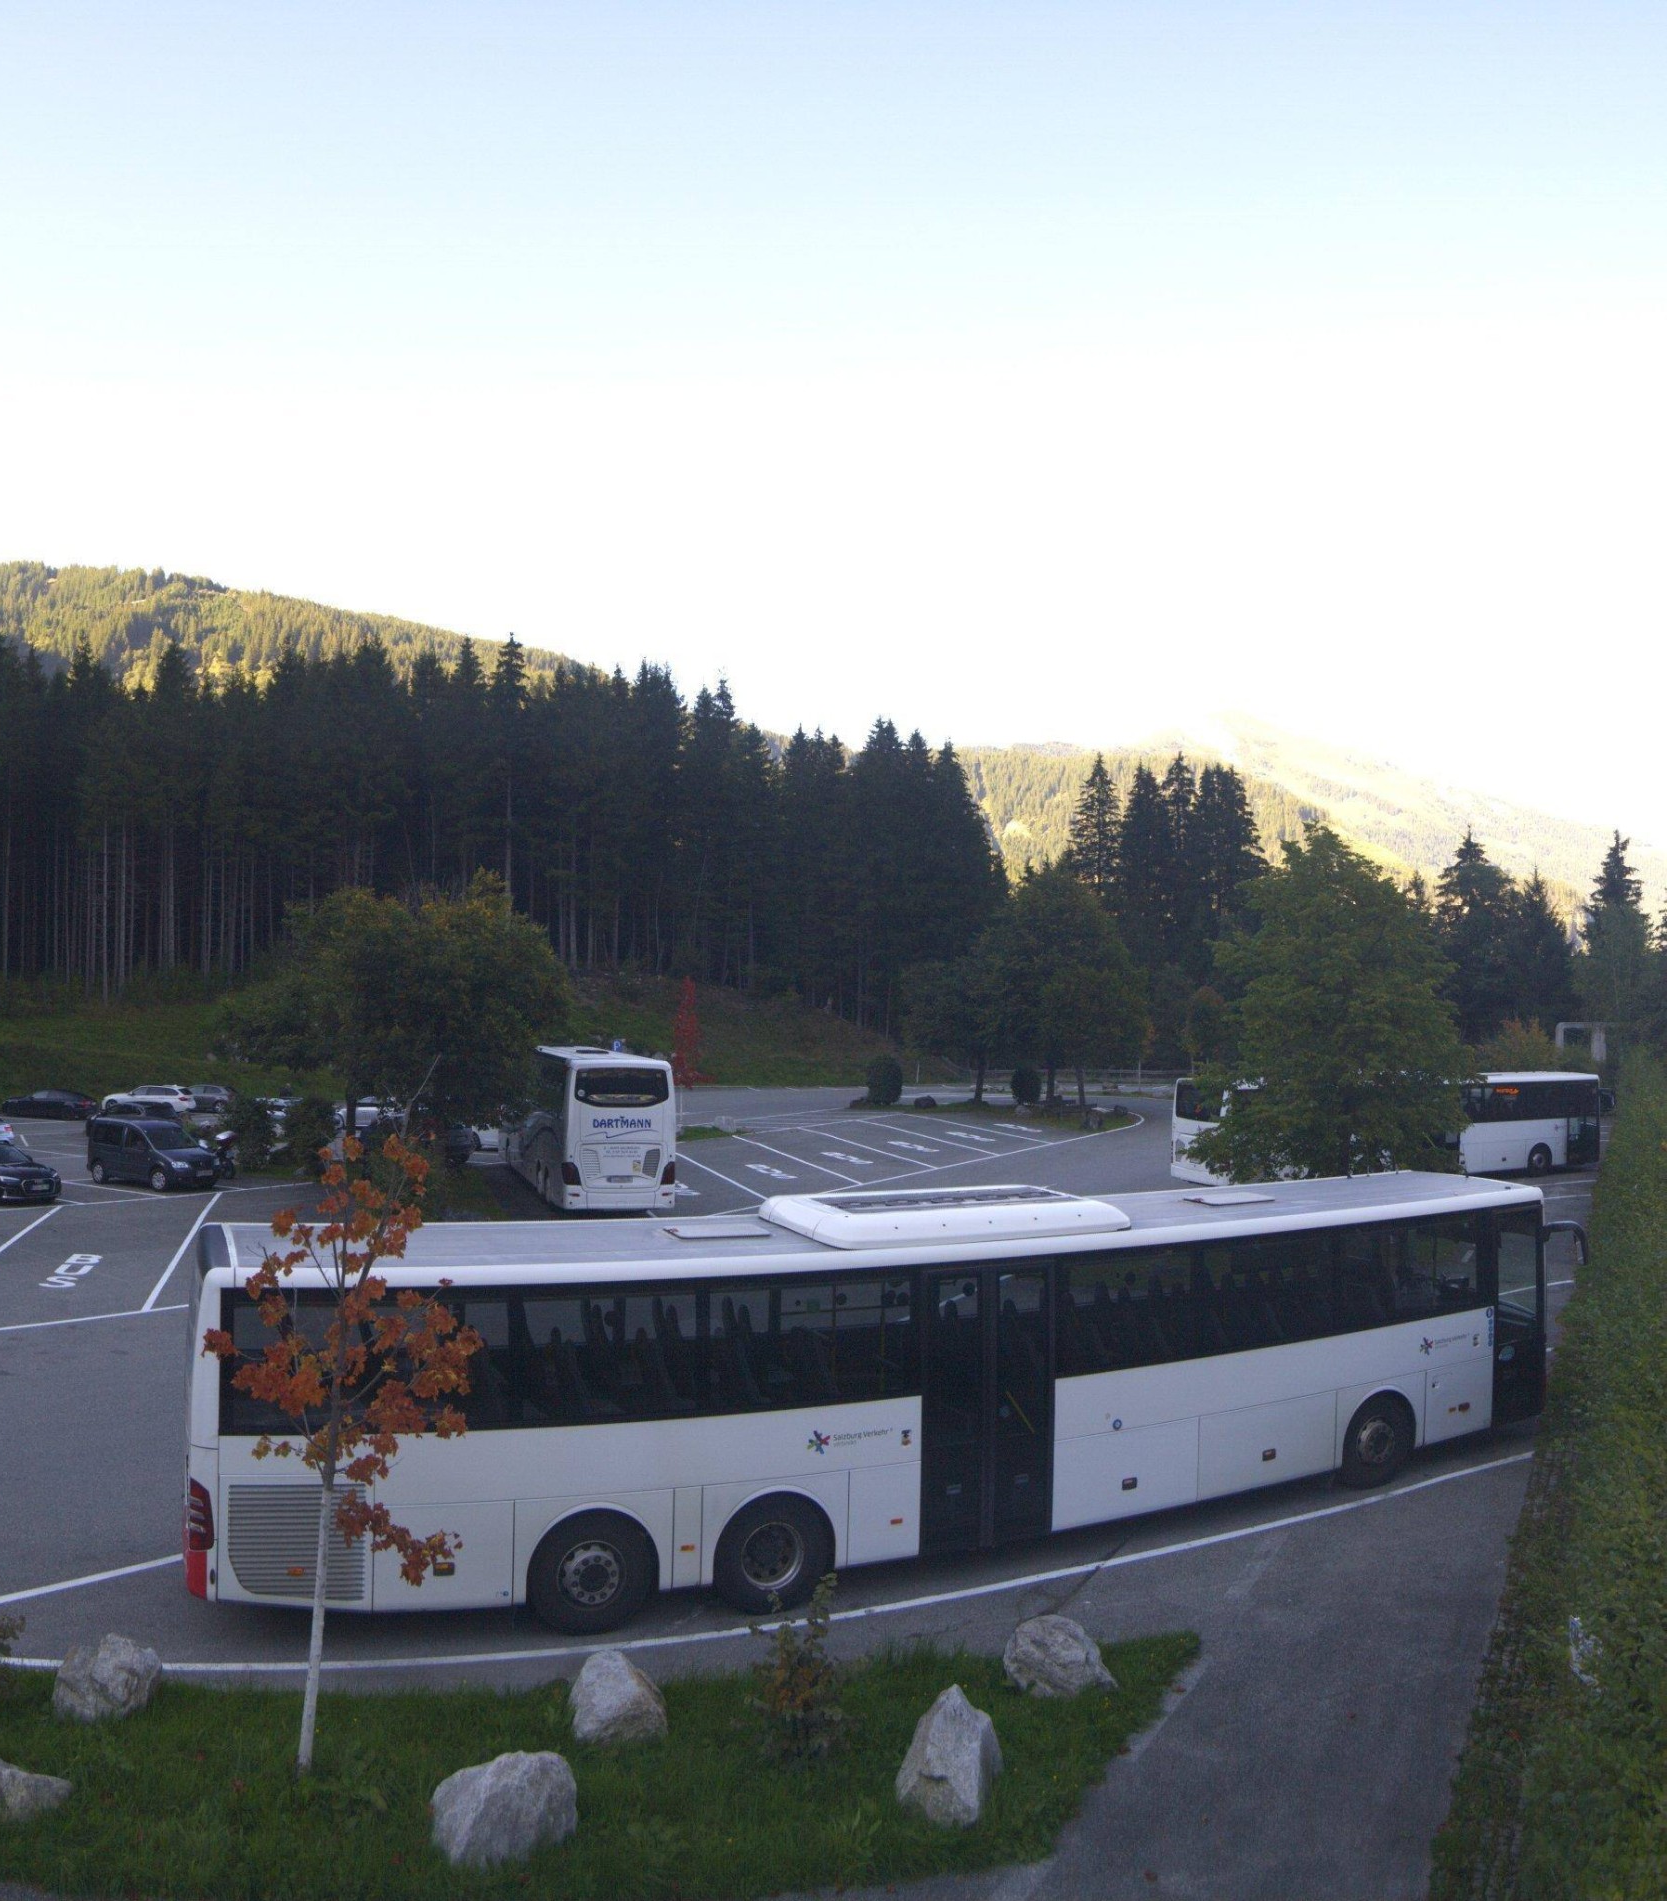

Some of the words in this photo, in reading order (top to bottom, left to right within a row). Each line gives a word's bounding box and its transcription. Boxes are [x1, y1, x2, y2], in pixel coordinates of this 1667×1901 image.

[592, 1118, 651, 1129] DARTMANN
[38, 1253, 104, 1288] BUS
[833, 1432, 862, 1441] Salzburg
